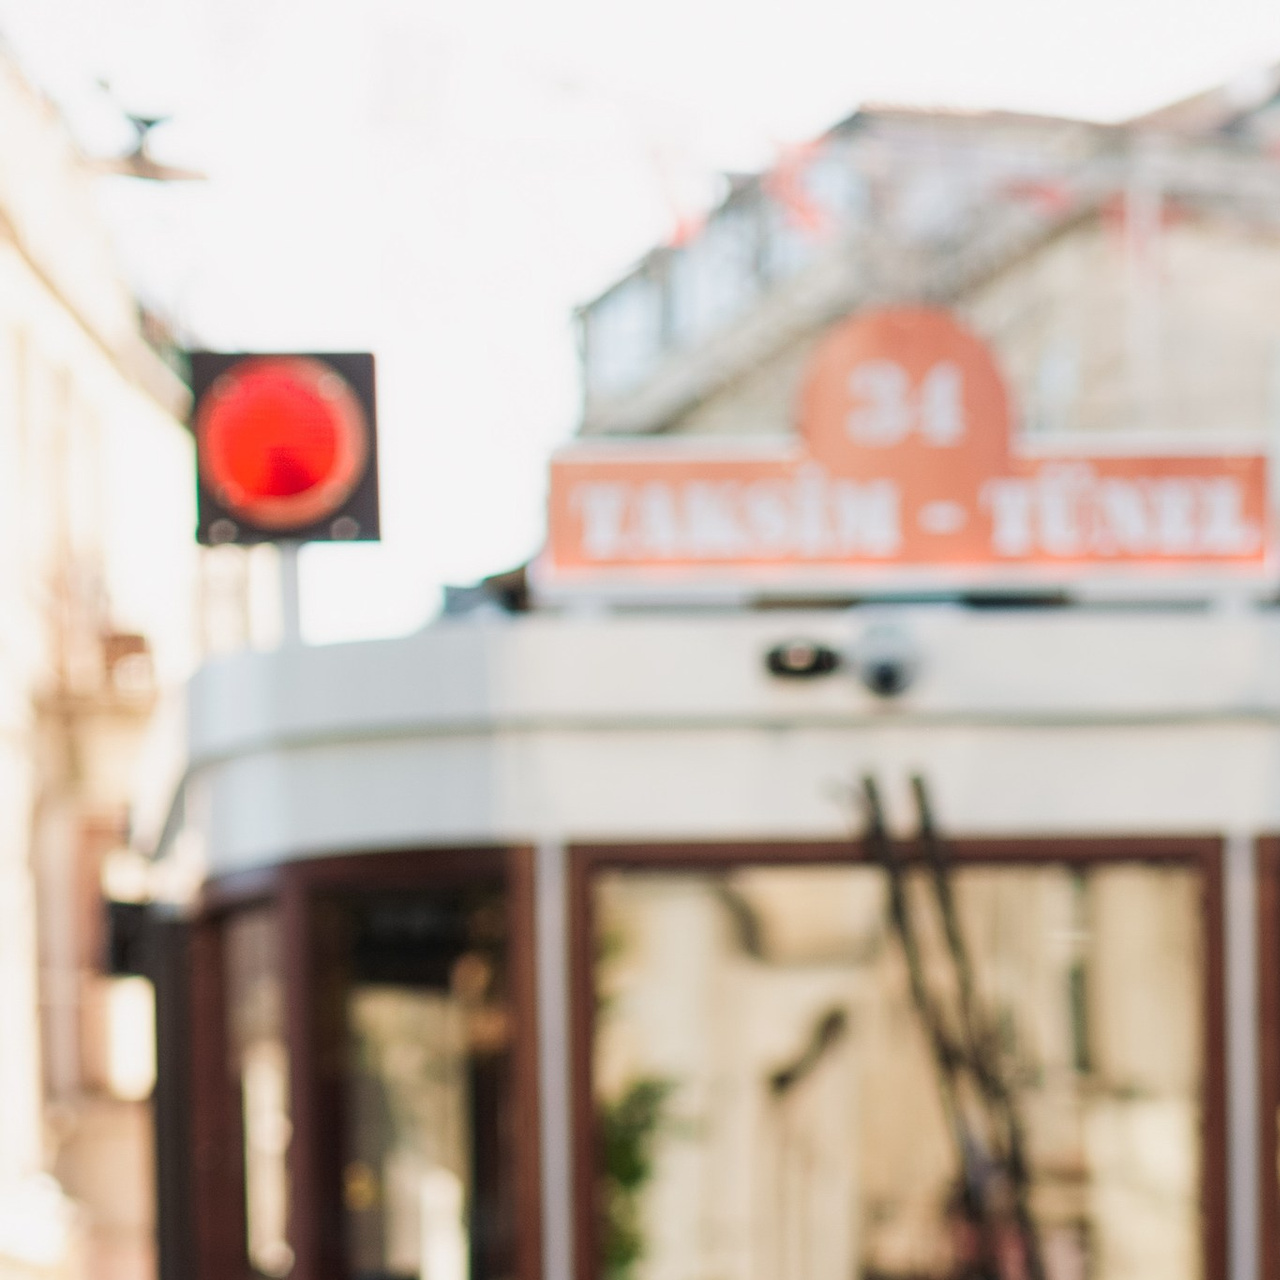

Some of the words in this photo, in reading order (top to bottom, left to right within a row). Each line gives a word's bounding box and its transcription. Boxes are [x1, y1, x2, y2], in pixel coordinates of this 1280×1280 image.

[846, 359, 962, 448] 34
[571, 464, 901, 559] TAKSİM
[982, 464, 1262, 559] TÜNEL
